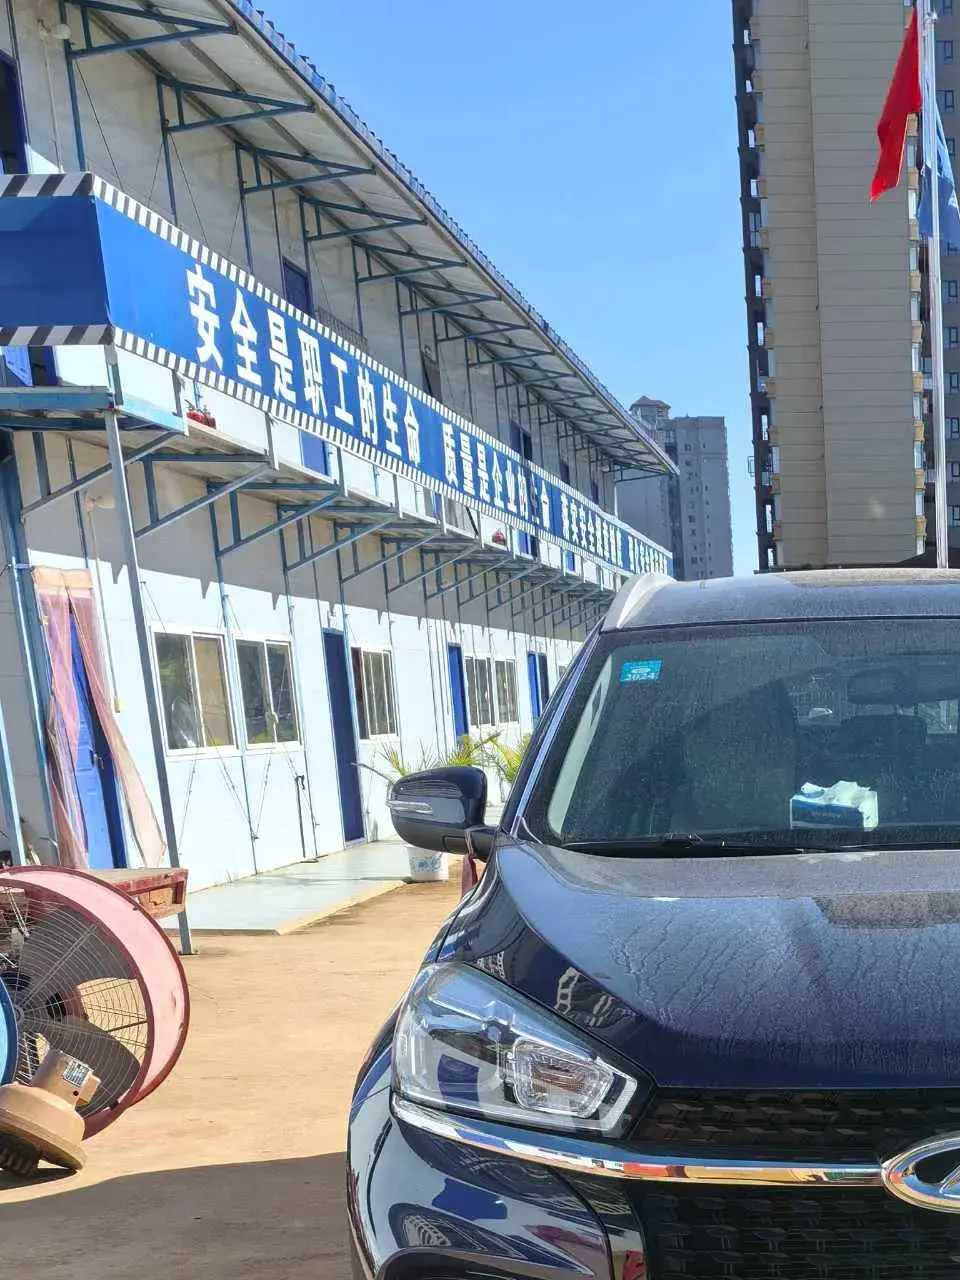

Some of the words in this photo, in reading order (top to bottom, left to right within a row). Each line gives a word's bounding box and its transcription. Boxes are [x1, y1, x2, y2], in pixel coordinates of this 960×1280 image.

[187, 263, 420, 467] 安全是职工的生命
